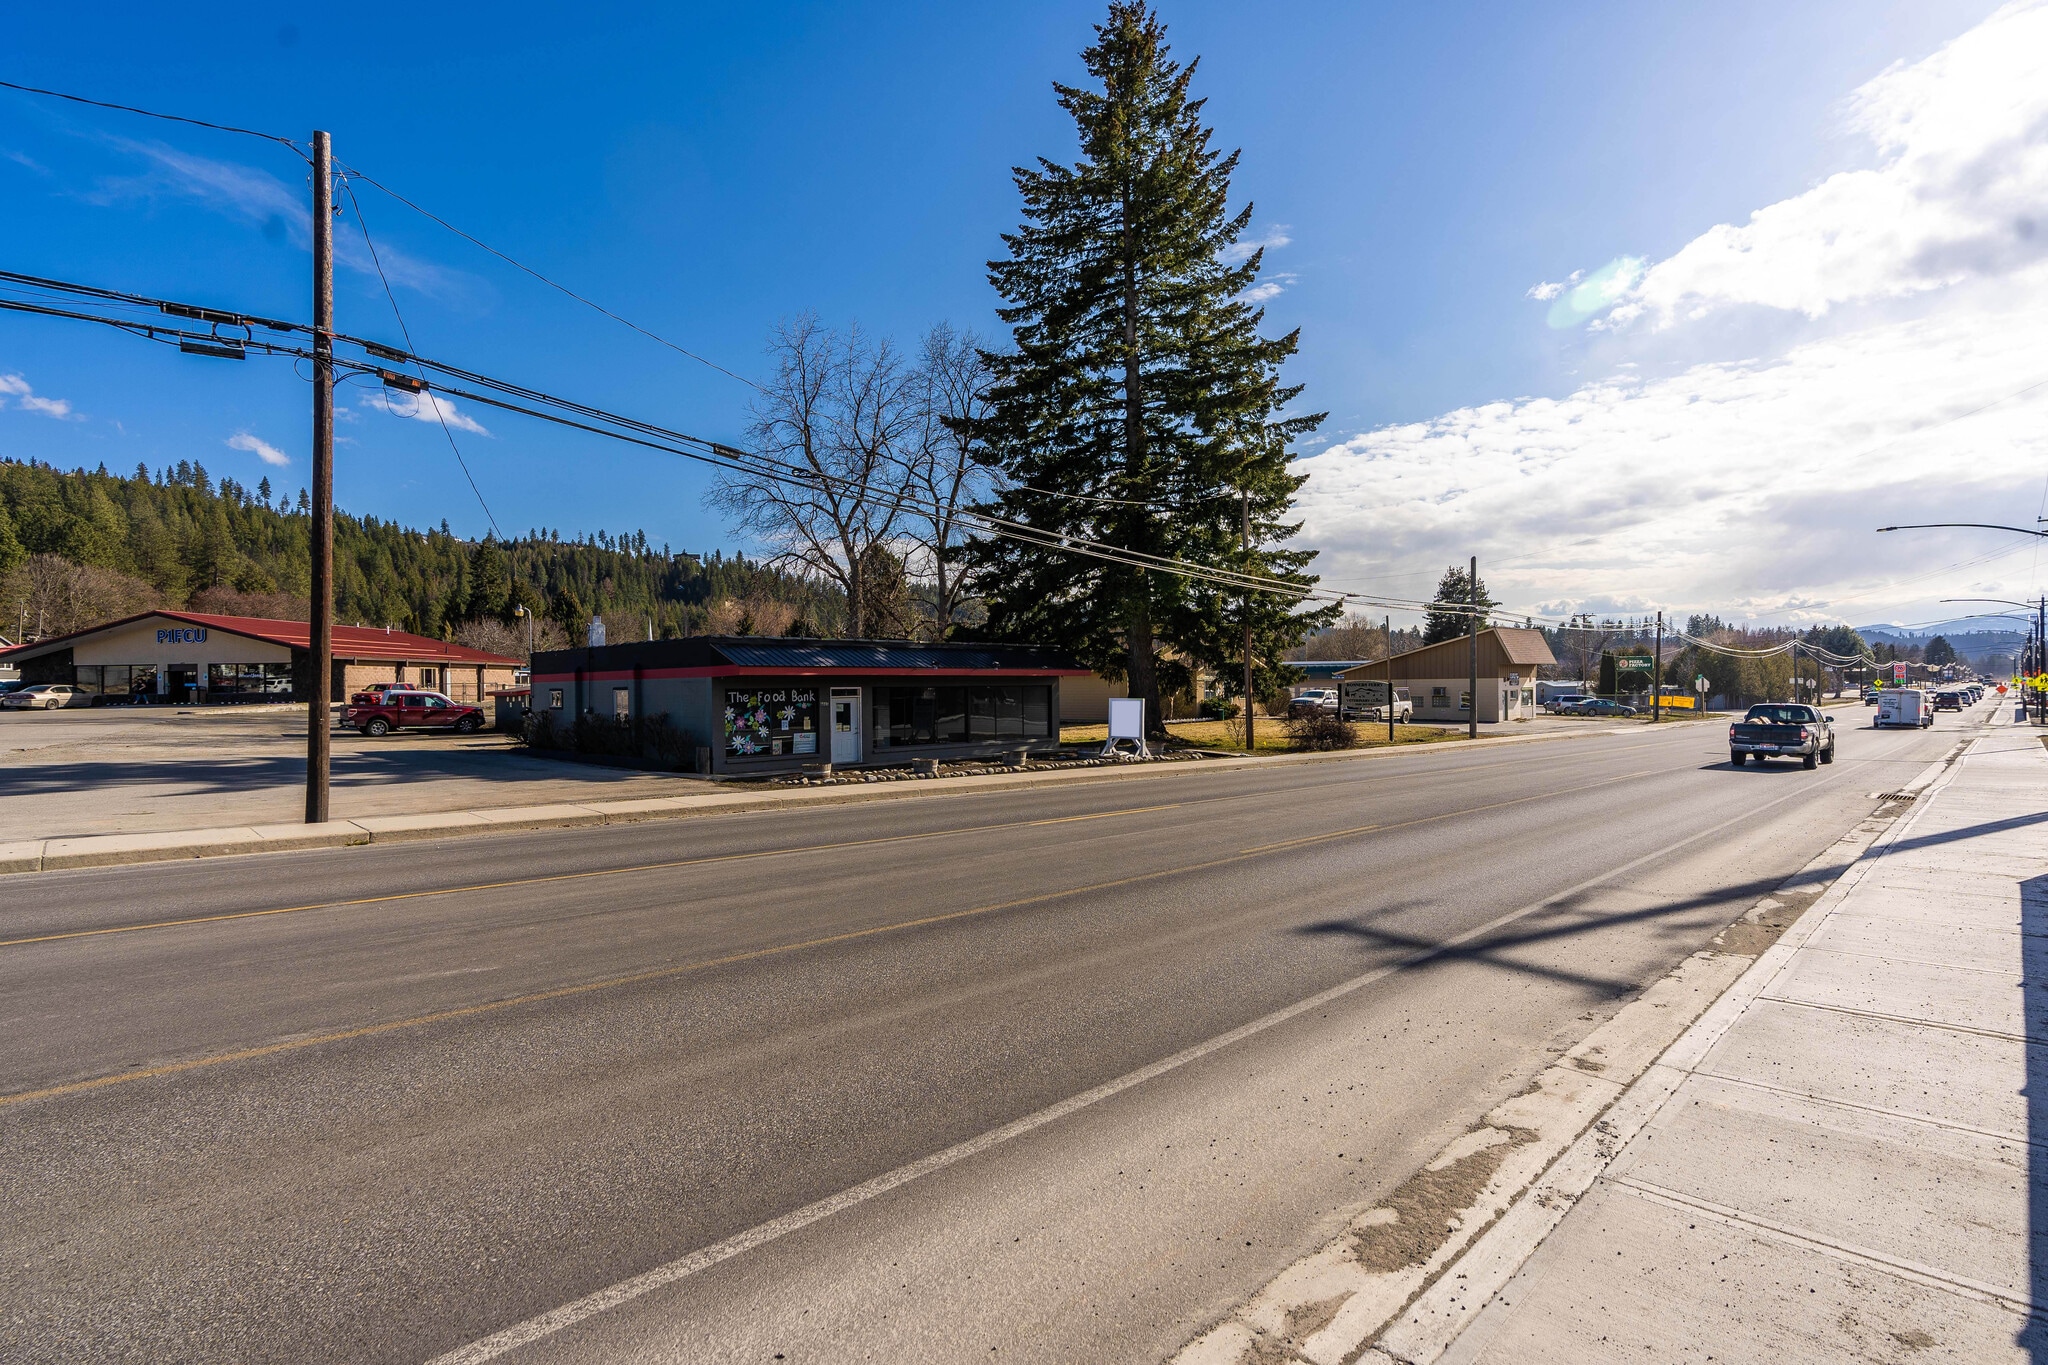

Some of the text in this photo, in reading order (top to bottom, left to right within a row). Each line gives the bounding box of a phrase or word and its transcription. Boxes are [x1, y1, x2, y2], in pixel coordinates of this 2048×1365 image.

[157, 628, 206, 644] P1FCU
[728, 690, 816, 703] The Food Bank
